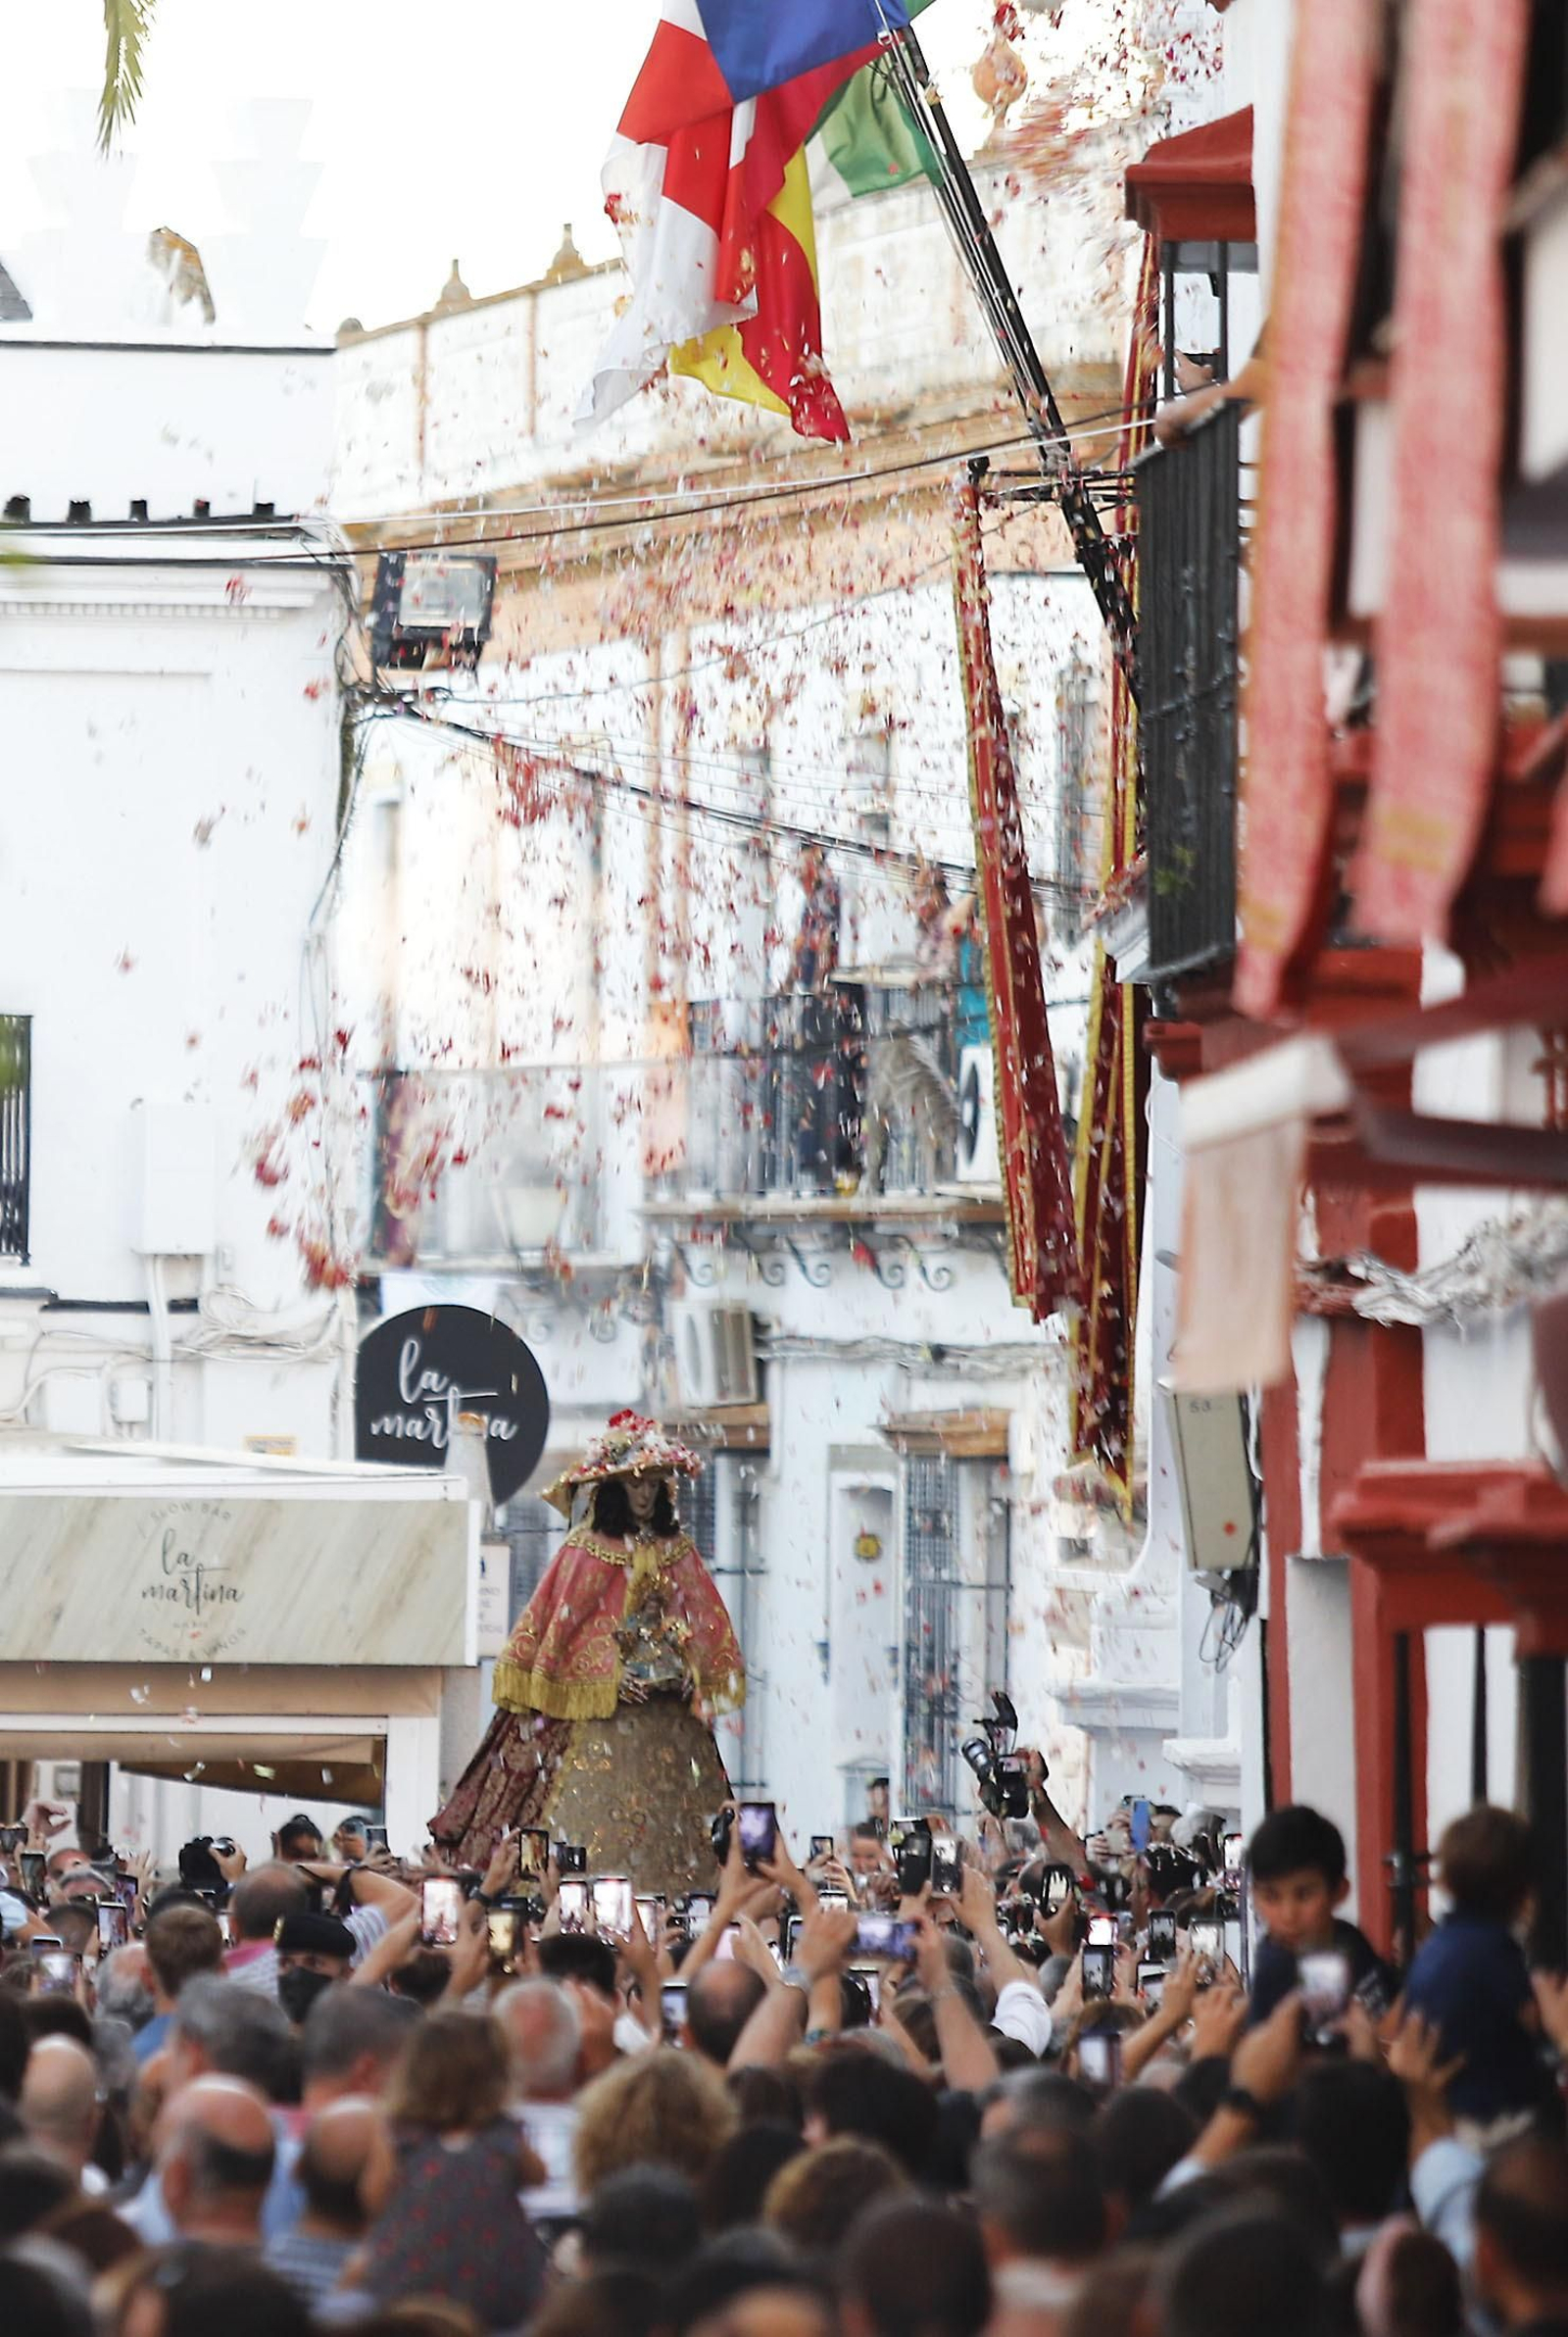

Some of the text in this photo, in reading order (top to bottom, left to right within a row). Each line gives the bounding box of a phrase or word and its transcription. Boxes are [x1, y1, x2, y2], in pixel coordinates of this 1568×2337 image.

[399, 1338, 448, 1404] la
[370, 1385, 518, 1449] marta
[162, 1527, 195, 1576] la
[141, 1563, 245, 1616] martina
